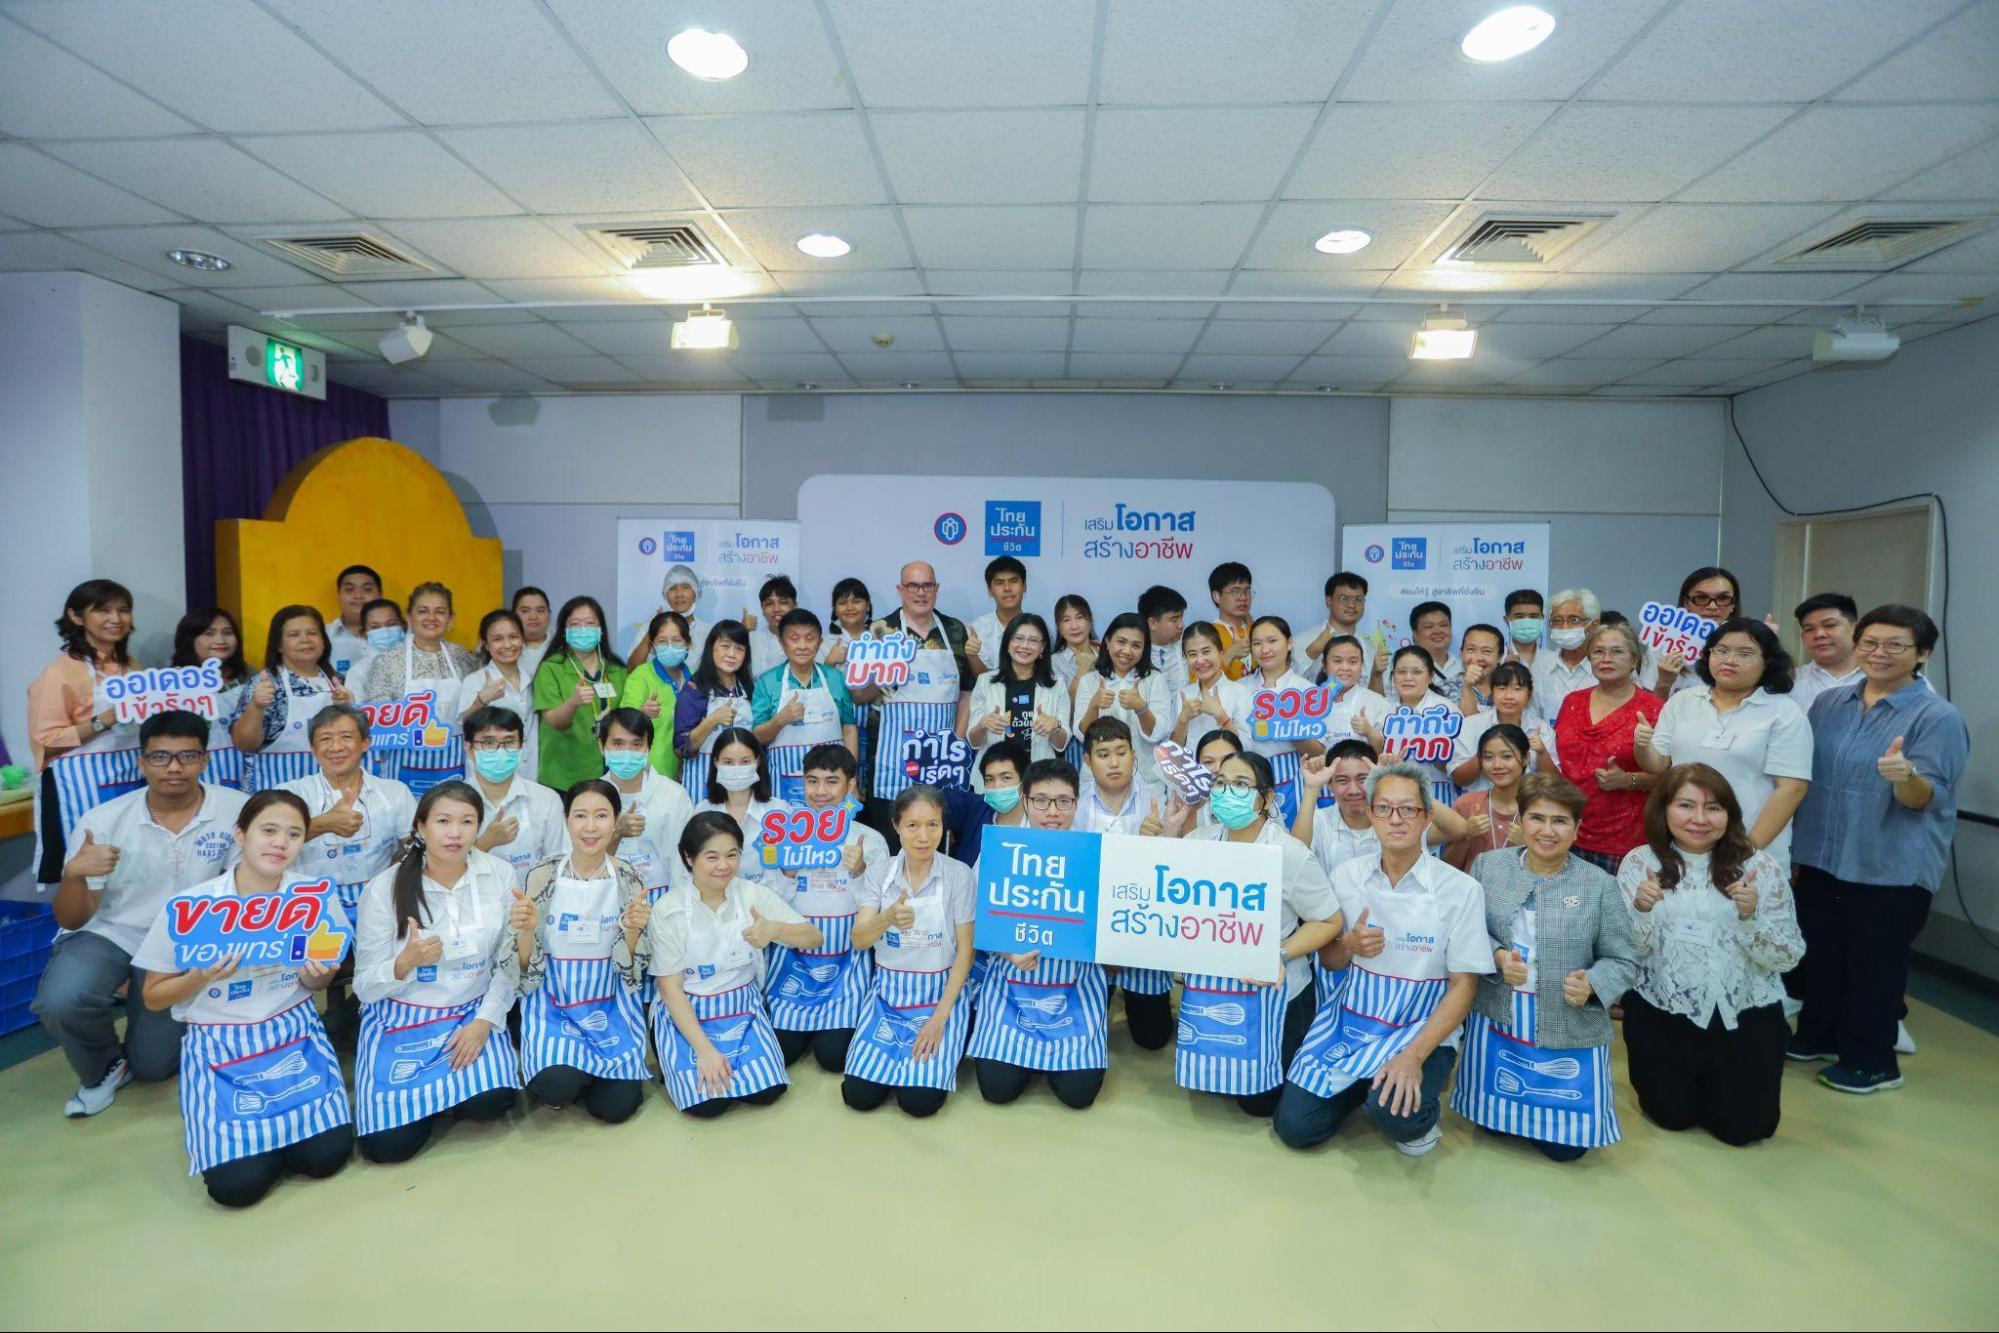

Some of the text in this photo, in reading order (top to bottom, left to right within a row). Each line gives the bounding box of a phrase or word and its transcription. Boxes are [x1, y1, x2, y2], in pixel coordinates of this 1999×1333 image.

[995, 506, 1025, 522] ไทย
[1084, 503, 1196, 532] เสริมโอกาส
[990, 522, 1035, 537] ประกัน
[1084, 534, 1194, 559] สร้างอาชีพ
[1452, 557, 1524, 571] สร้างอาชีพ
[1643, 604, 1716, 640] ออเดอ
[848, 632, 915, 660] ทำถึง
[1642, 626, 1704, 661] เข้ารัว
[106, 660, 219, 699] ออเดอร์
[847, 661, 907, 684] มาก
[361, 692, 432, 727] ายดี
[1254, 687, 1330, 720] รวย
[1273, 720, 1323, 738] ไม่ไหว
[1386, 706, 1459, 735] ทำถึง
[370, 728, 411, 747] งแทร่
[902, 729, 966, 762] กำไร
[919, 759, 965, 785] เริ่ดๆ
[762, 808, 846, 845] รวย
[783, 845, 837, 866] ไม่ไหว
[1001, 841, 1066, 880] ไทย
[988, 876, 1085, 914] ประกัน
[1112, 864, 1268, 912] เสริมโอกาส
[175, 880, 330, 934] ขายดี
[1014, 922, 1054, 946] ชีวิต
[1110, 903, 1264, 946] สร้างอาชีพ
